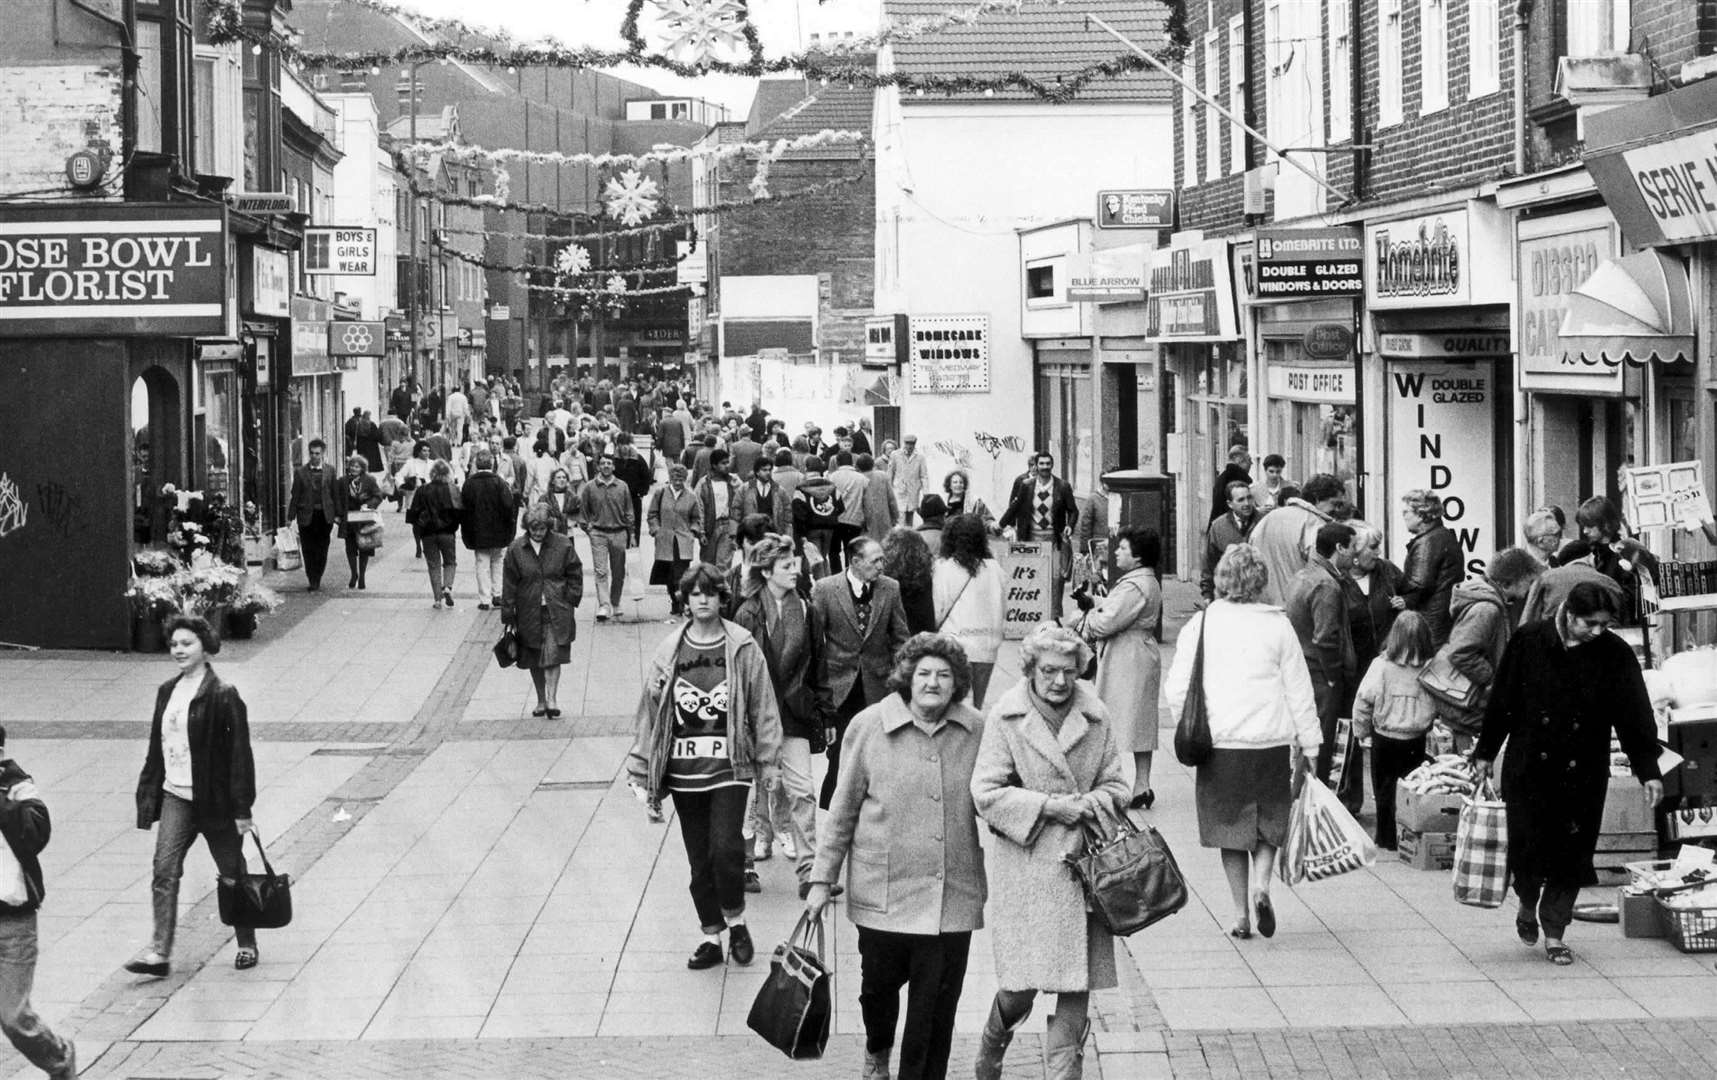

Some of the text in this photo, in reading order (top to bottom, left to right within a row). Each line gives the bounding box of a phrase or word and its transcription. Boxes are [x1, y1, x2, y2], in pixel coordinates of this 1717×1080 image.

[1637, 160, 1717, 220] SERVE
[237, 199, 291, 210] INTERFLORA
[1122, 193, 1168, 207] Kentucky
[1122, 214, 1161, 224] Chicken
[336, 231, 364, 242] BOYS
[81, 237, 212, 268] BOWL
[337, 247, 369, 257] GIRLS
[1258, 238, 1336, 259] HOMEBRITE
[1375, 217, 1459, 297] Homebrite
[339, 262, 368, 272] WEAR
[1262, 264, 1359, 277] DOUBLE GLAZED
[0, 270, 174, 301] FLORIST
[1071, 277, 1140, 286] BLUE ARROW
[1259, 280, 1362, 292] WINDOWS & DOORS
[916, 330, 982, 341] HOMECARE
[919, 348, 980, 360] WINDOWS
[1288, 372, 1343, 392] POST OFFICE
[1432, 379, 1485, 391] DOUBLE
[1432, 392, 1485, 403] GLAZED
[1010, 546, 1040, 554] POST
[1012, 566, 1037, 580] It's
[1007, 587, 1041, 601] First
[1006, 608, 1043, 622] Class
